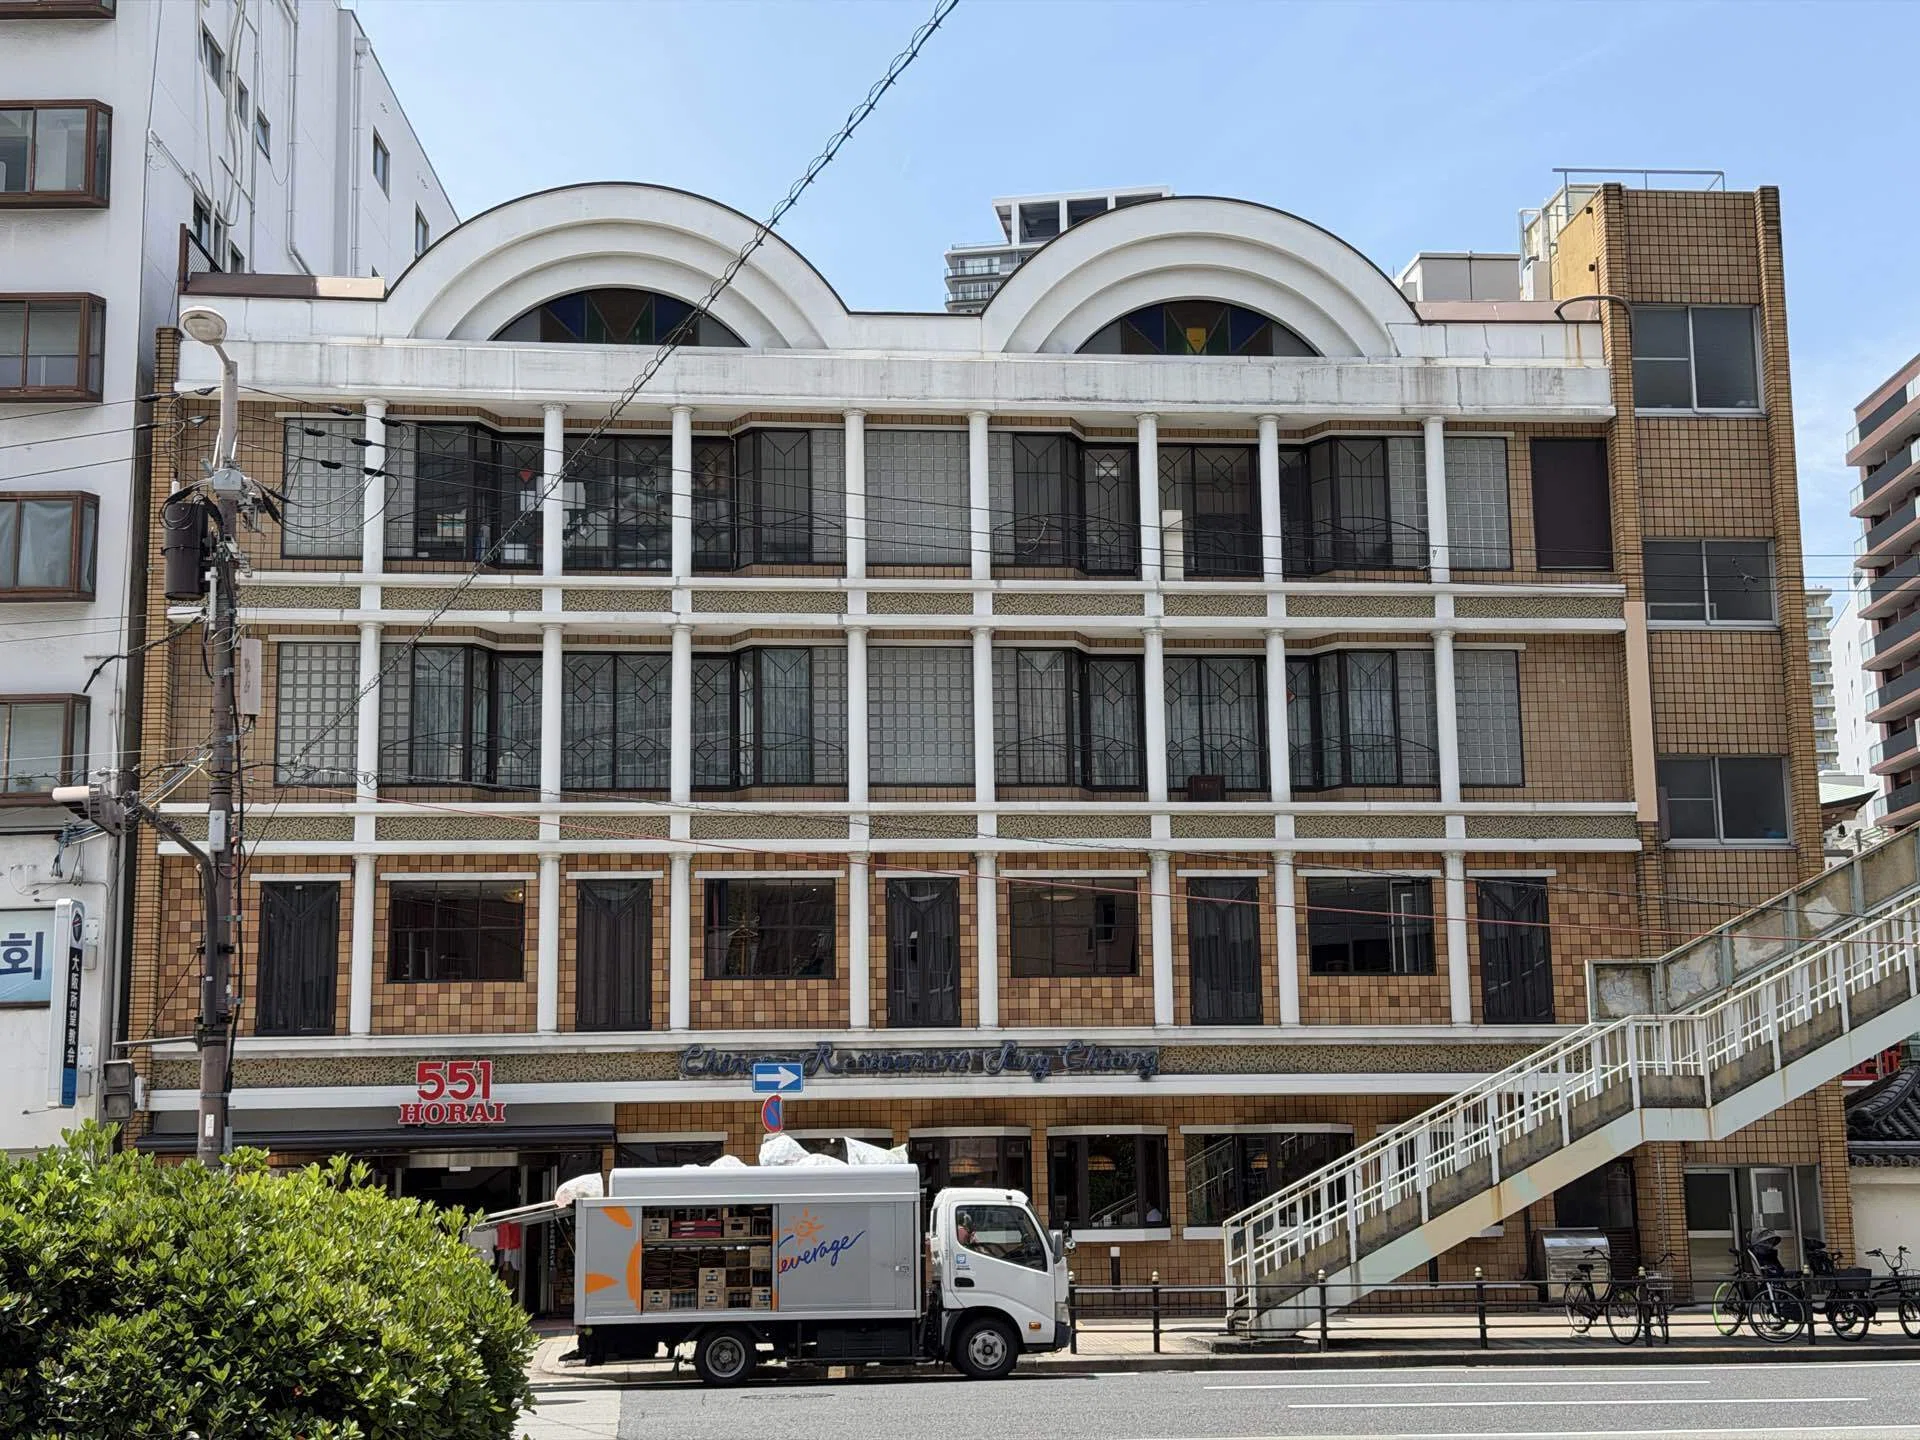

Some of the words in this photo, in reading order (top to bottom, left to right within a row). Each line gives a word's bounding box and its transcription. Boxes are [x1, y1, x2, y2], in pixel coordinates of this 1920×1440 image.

[0, 932, 44, 980] 회
[416, 1061, 492, 1101] 551
[398, 1103, 506, 1124] HORAI
[778, 1230, 866, 1273] everage
